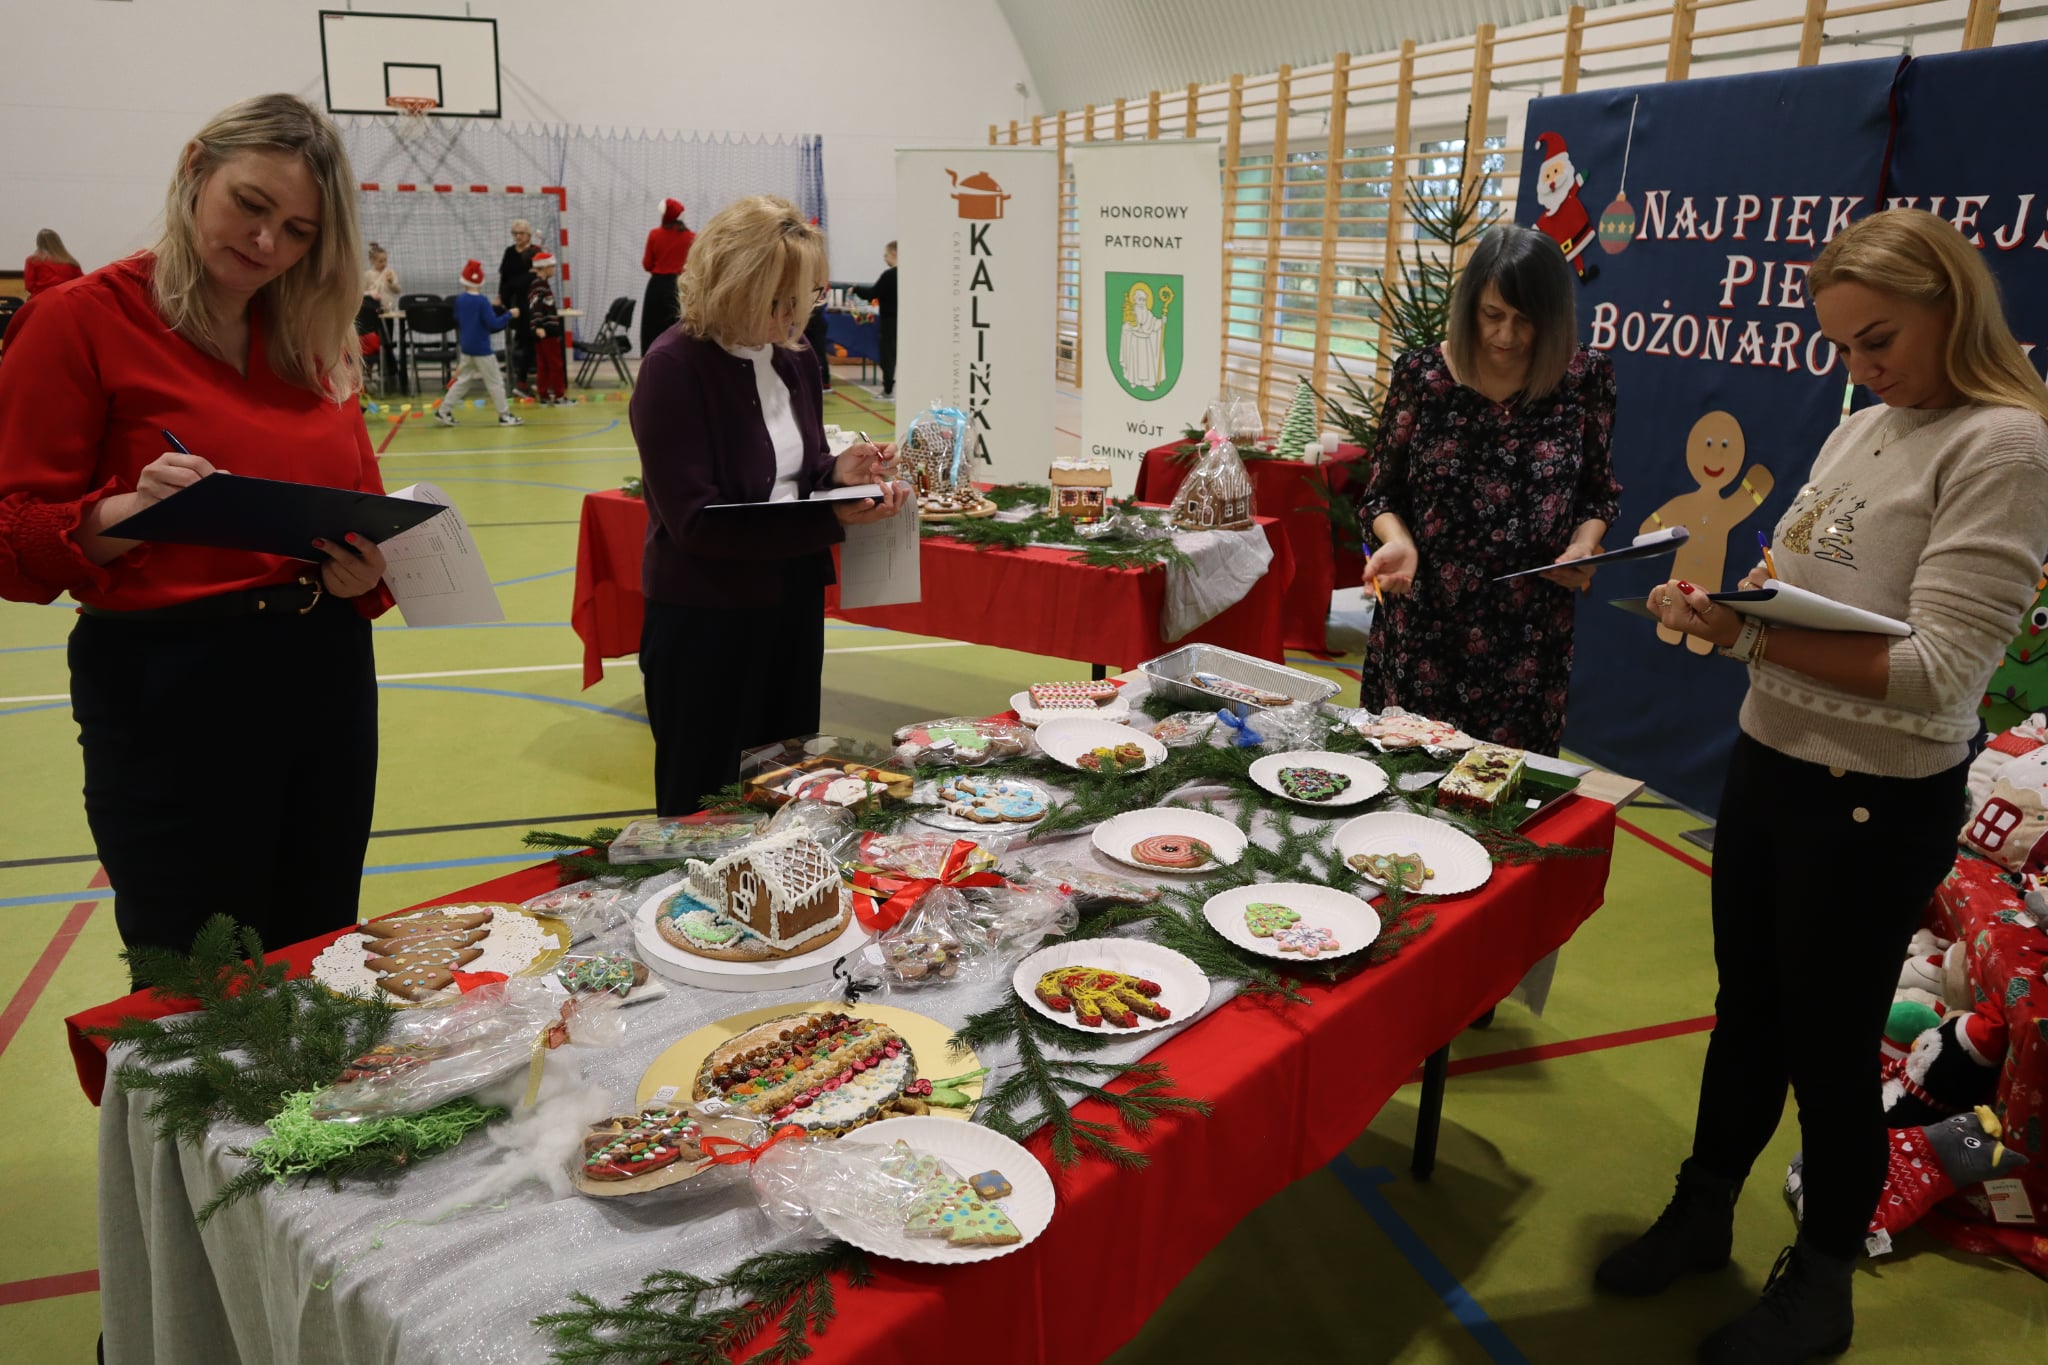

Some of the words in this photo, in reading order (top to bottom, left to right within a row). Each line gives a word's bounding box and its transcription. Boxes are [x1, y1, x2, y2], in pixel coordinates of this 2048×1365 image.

[1100, 205, 1188, 219] HONOROWY
[1105, 234, 1183, 249] PATRONAT
[952, 231, 961, 297] CATERING
[1719, 254, 1817, 308] PIE
[1589, 299, 1839, 376] BOŻONARO
[952, 352, 961, 407] SUWALSZ
[1126, 420, 1164, 437] WÓJT
[1092, 444, 1133, 460] GMINY
